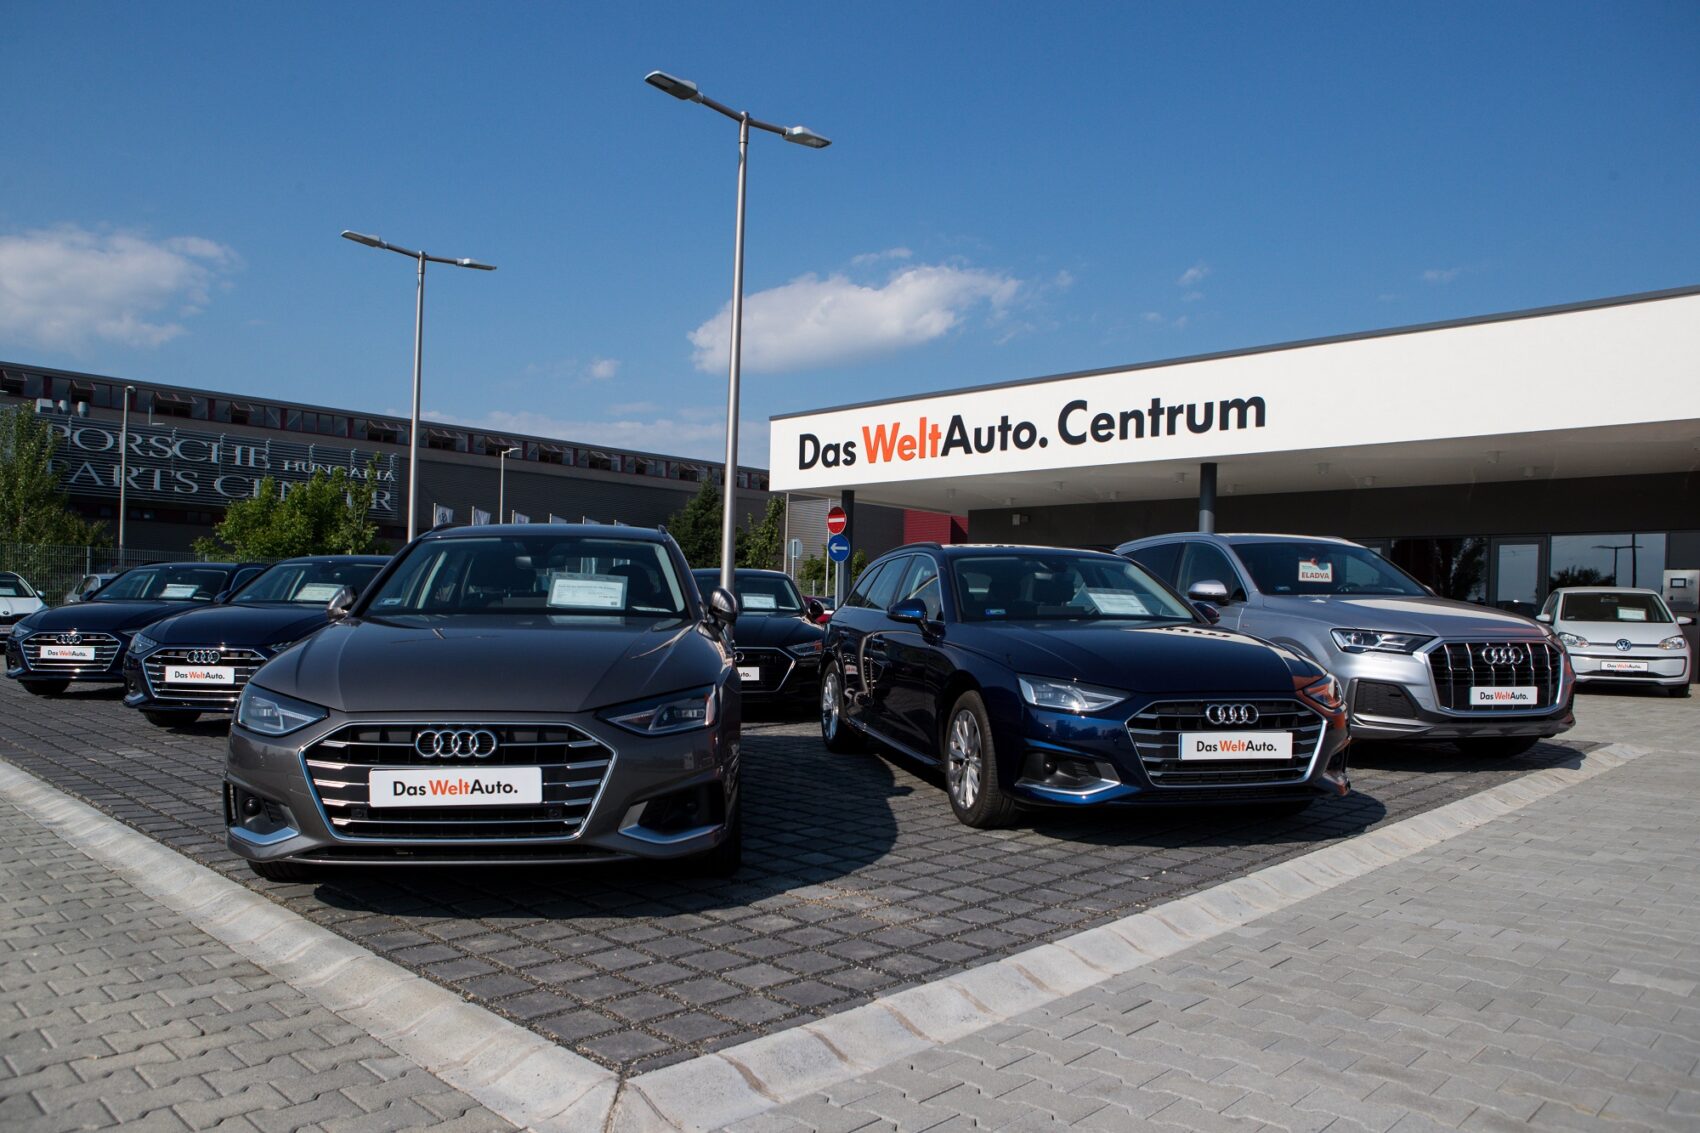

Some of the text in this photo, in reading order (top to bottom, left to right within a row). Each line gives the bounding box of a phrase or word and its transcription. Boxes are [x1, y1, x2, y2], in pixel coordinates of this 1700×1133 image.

[798, 396, 1267, 471] Das WeltAuto. Centrum
[46, 423, 271, 469] PORSCHE
[47, 458, 199, 495] PARTS
[1301, 571, 1330, 580] ELADVA
[47, 649, 88, 657] Das WeltAuto.
[174, 670, 225, 680] Das WeltAuto.
[1479, 690, 1529, 701] Das WeltAuto.
[1196, 739, 1278, 753] Das WeltAuto.
[392, 777, 519, 798] Das WeltAuto.
